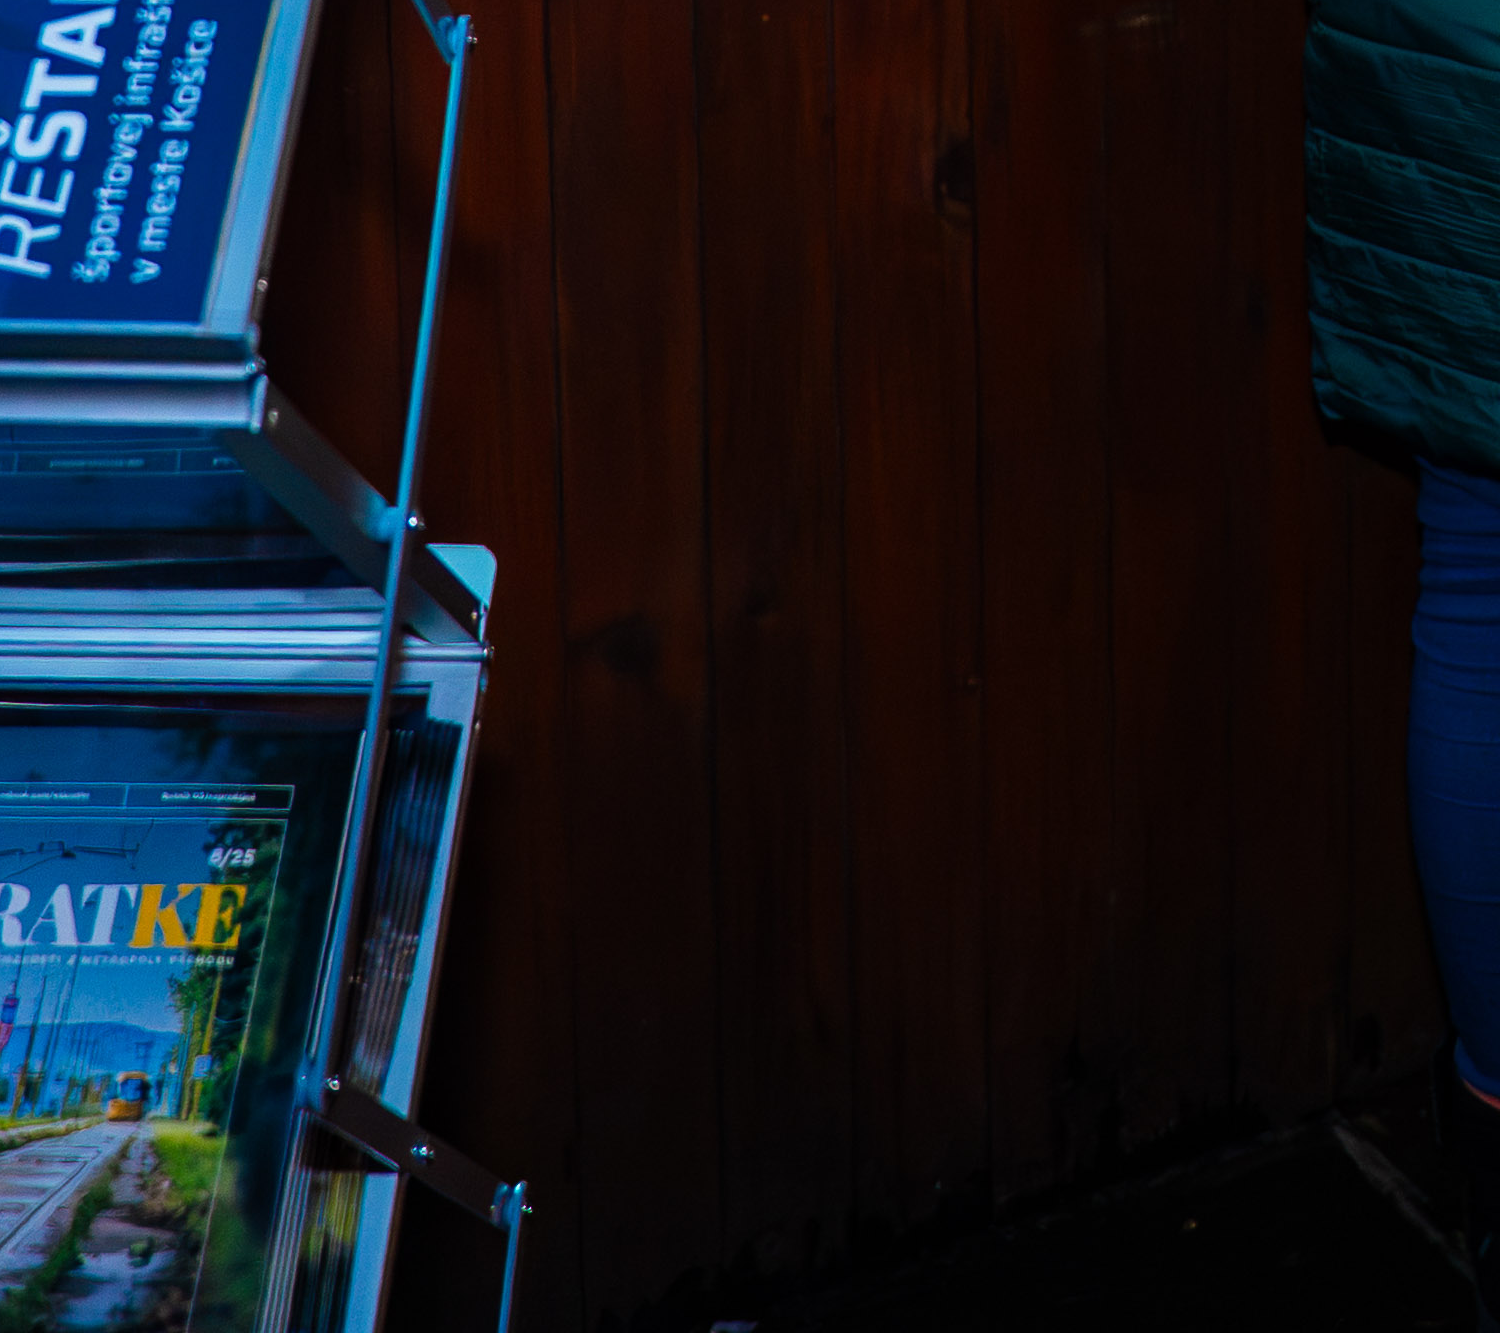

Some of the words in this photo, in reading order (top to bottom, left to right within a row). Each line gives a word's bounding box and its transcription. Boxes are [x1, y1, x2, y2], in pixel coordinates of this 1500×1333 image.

[160, 18, 218, 132] Košice
[71, 111, 153, 283] športovej
[137, 138, 190, 253] meste
[129, 257, 162, 284] v
